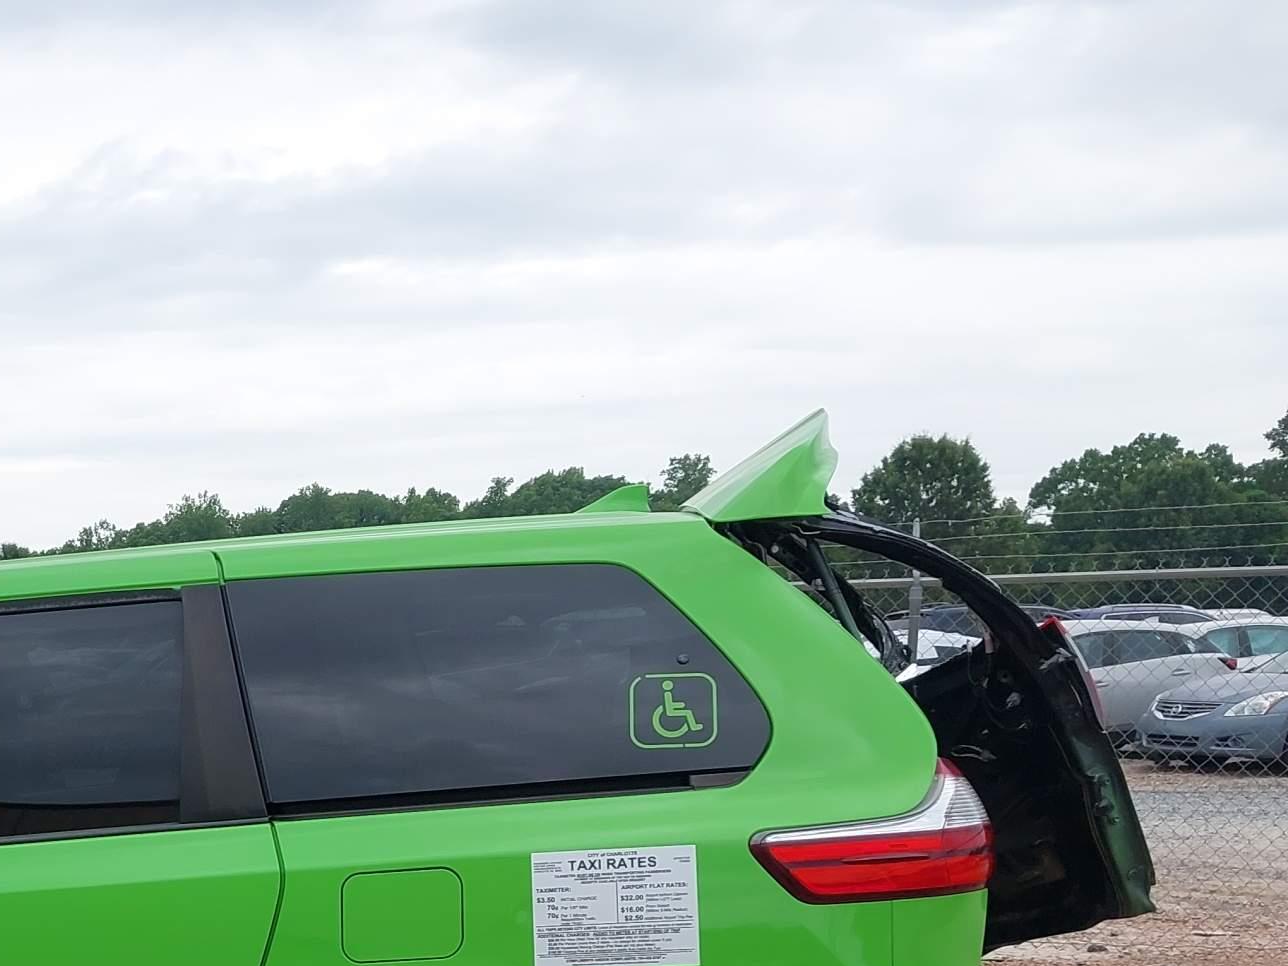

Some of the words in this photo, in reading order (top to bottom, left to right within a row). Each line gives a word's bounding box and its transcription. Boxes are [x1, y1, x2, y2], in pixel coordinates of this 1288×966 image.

[568, 859, 602, 871] TAXI
[607, 856, 657, 870] RATES
[536, 896, 556, 904] $3.50
